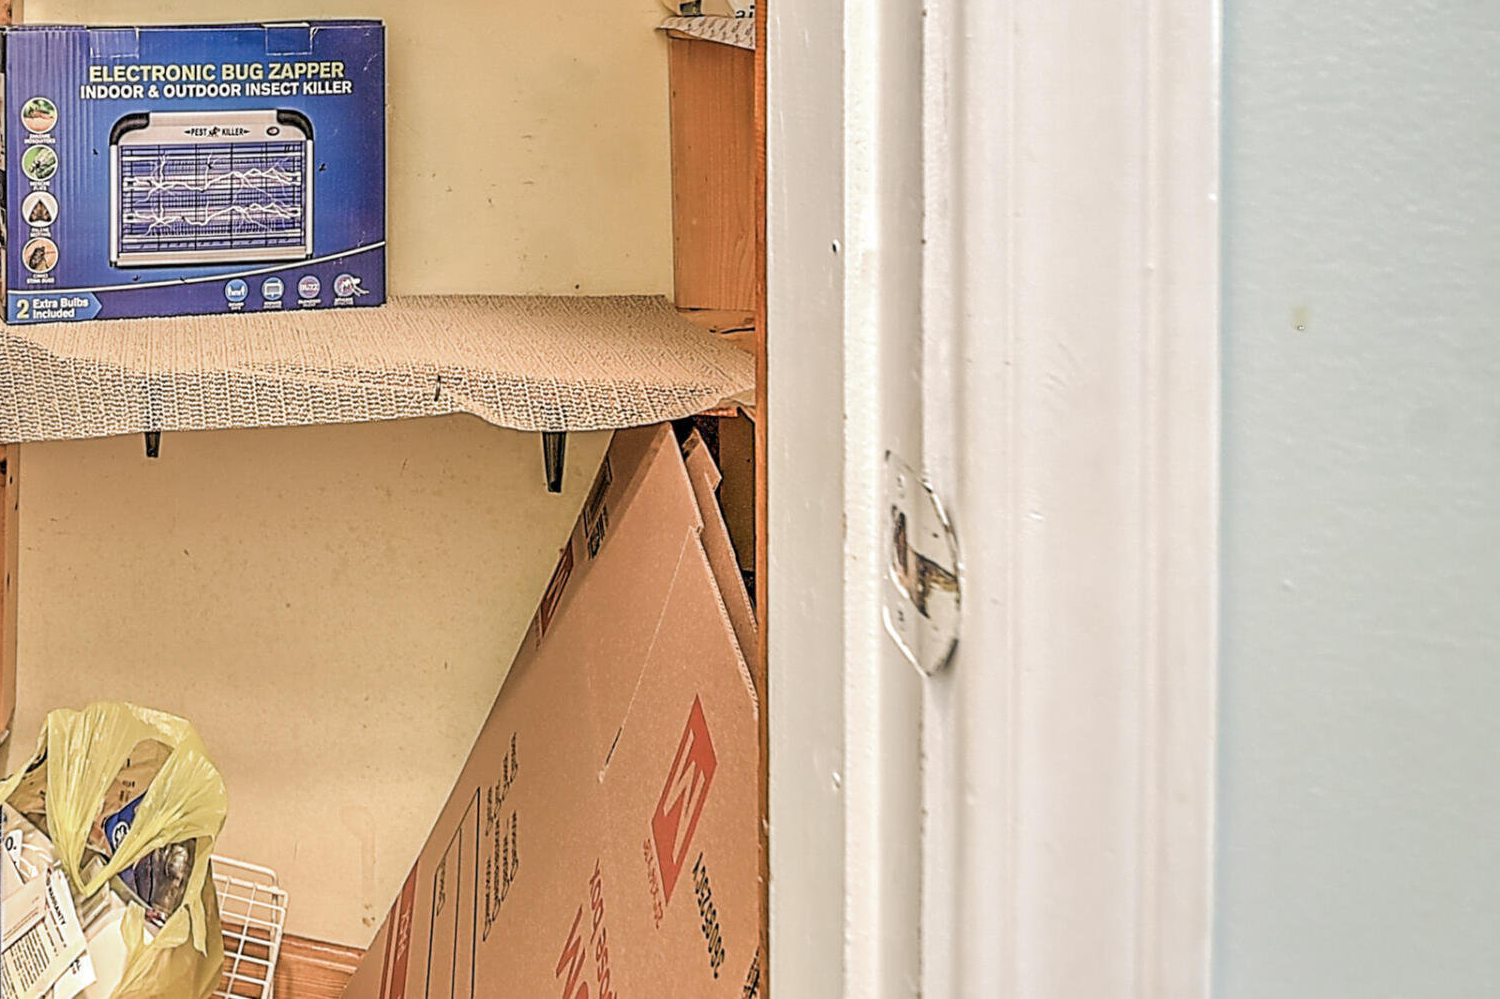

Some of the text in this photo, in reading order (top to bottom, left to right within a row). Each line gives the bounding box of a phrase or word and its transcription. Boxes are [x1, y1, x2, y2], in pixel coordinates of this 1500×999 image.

[89, 62, 345, 83] ELECTRONIC BUG ZAPPER
[81, 81, 352, 99] INDOOR & OUTDOOR INSECT KILLER
[191, 127, 244, 137] PEST KILLER
[16, 297, 89, 319] 2 Extra Bulbs
[32, 308, 75, 319] Included
[48, 886, 66, 926] WARRANTY
